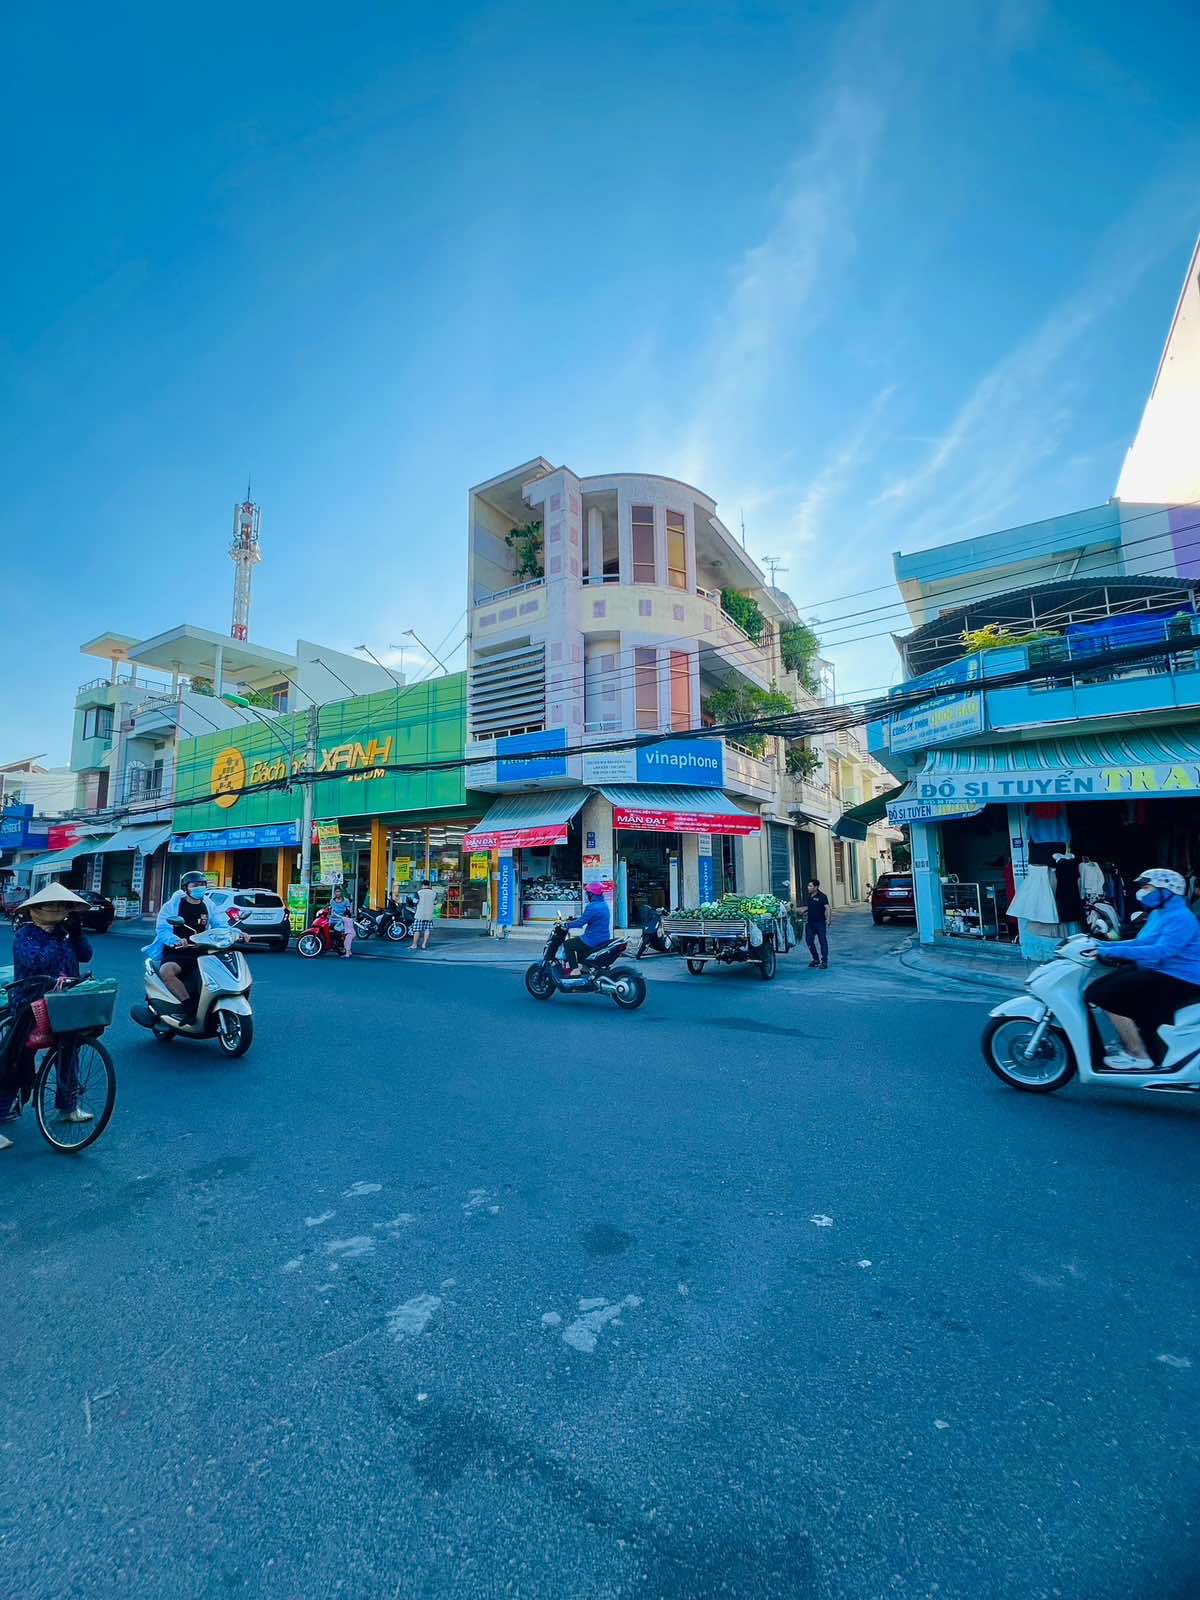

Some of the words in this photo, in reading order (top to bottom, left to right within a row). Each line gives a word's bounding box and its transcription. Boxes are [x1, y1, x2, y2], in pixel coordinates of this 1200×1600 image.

[250, 757, 287, 785] Bách
[319, 735, 394, 773] XANH
[645, 750, 719, 769] vinaphone
[920, 777, 956, 797] ĐỒ
[963, 781, 988, 797] SI
[1098, 766, 1200, 793] TRA
[500, 865, 509, 917] vinaphone
